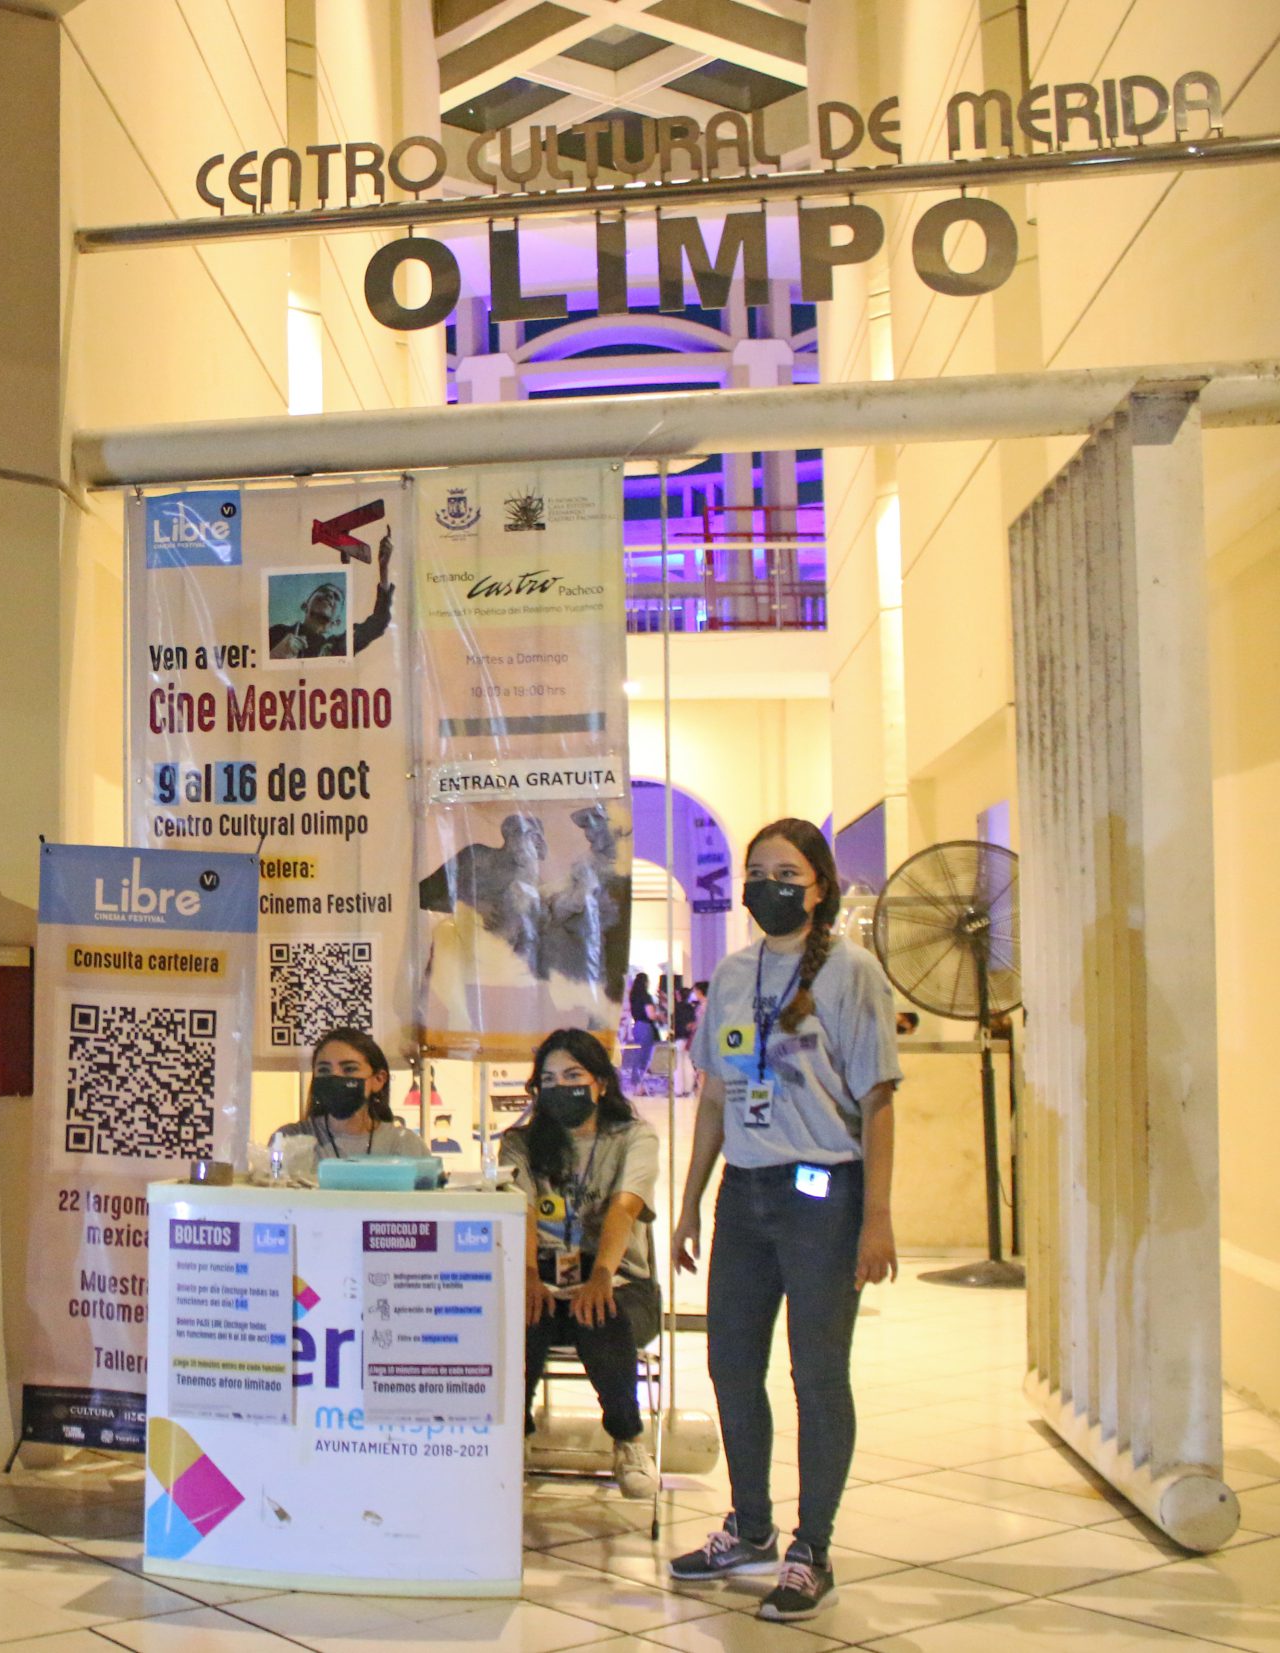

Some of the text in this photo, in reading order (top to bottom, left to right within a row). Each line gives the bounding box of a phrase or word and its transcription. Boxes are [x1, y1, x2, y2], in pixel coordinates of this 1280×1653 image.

[466, 109, 781, 187] CULTURAL
[818, 95, 903, 162] DE
[363, 194, 1020, 331] OLIMPO
[153, 501, 231, 543] Libre
[467, 568, 564, 599] Castro
[558, 584, 604, 596] Pacheco
[149, 644, 257, 672] Ven a ver:
[507, 656, 514, 665] a
[516, 653, 569, 668] Domingo
[149, 678, 392, 734] Cine Mexicano
[158, 759, 371, 803] 9 al 16 de oct
[439, 769, 616, 792] ENTRADA GRATUITA
[154, 810, 368, 842] Centro Cultural Olimpo
[259, 858, 315, 879] telera:
[94, 856, 202, 917] Libre
[259, 891, 392, 914] Cinema Festival
[94, 913, 166, 924] CINEMA FESTIVAL
[74, 948, 220, 973] Consulta cartelera
[58, 1189, 80, 1212] 22
[174, 1224, 232, 1247] BOLETOS
[369, 1223, 430, 1236] PROTOCOLO DE
[369, 1236, 417, 1249] SEGURIDAD
[80, 1269, 148, 1297] Muestr
[69, 1298, 148, 1323] cortome
[94, 1346, 148, 1374] Taller
[176, 1373, 282, 1392] Tenemos aforo limitado
[372, 1380, 486, 1394] Tenemos aforo limitado
[69, 1405, 115, 1418] CULTURA
[315, 1439, 490, 1457] AYUNTAMIENTO 2018-2021
